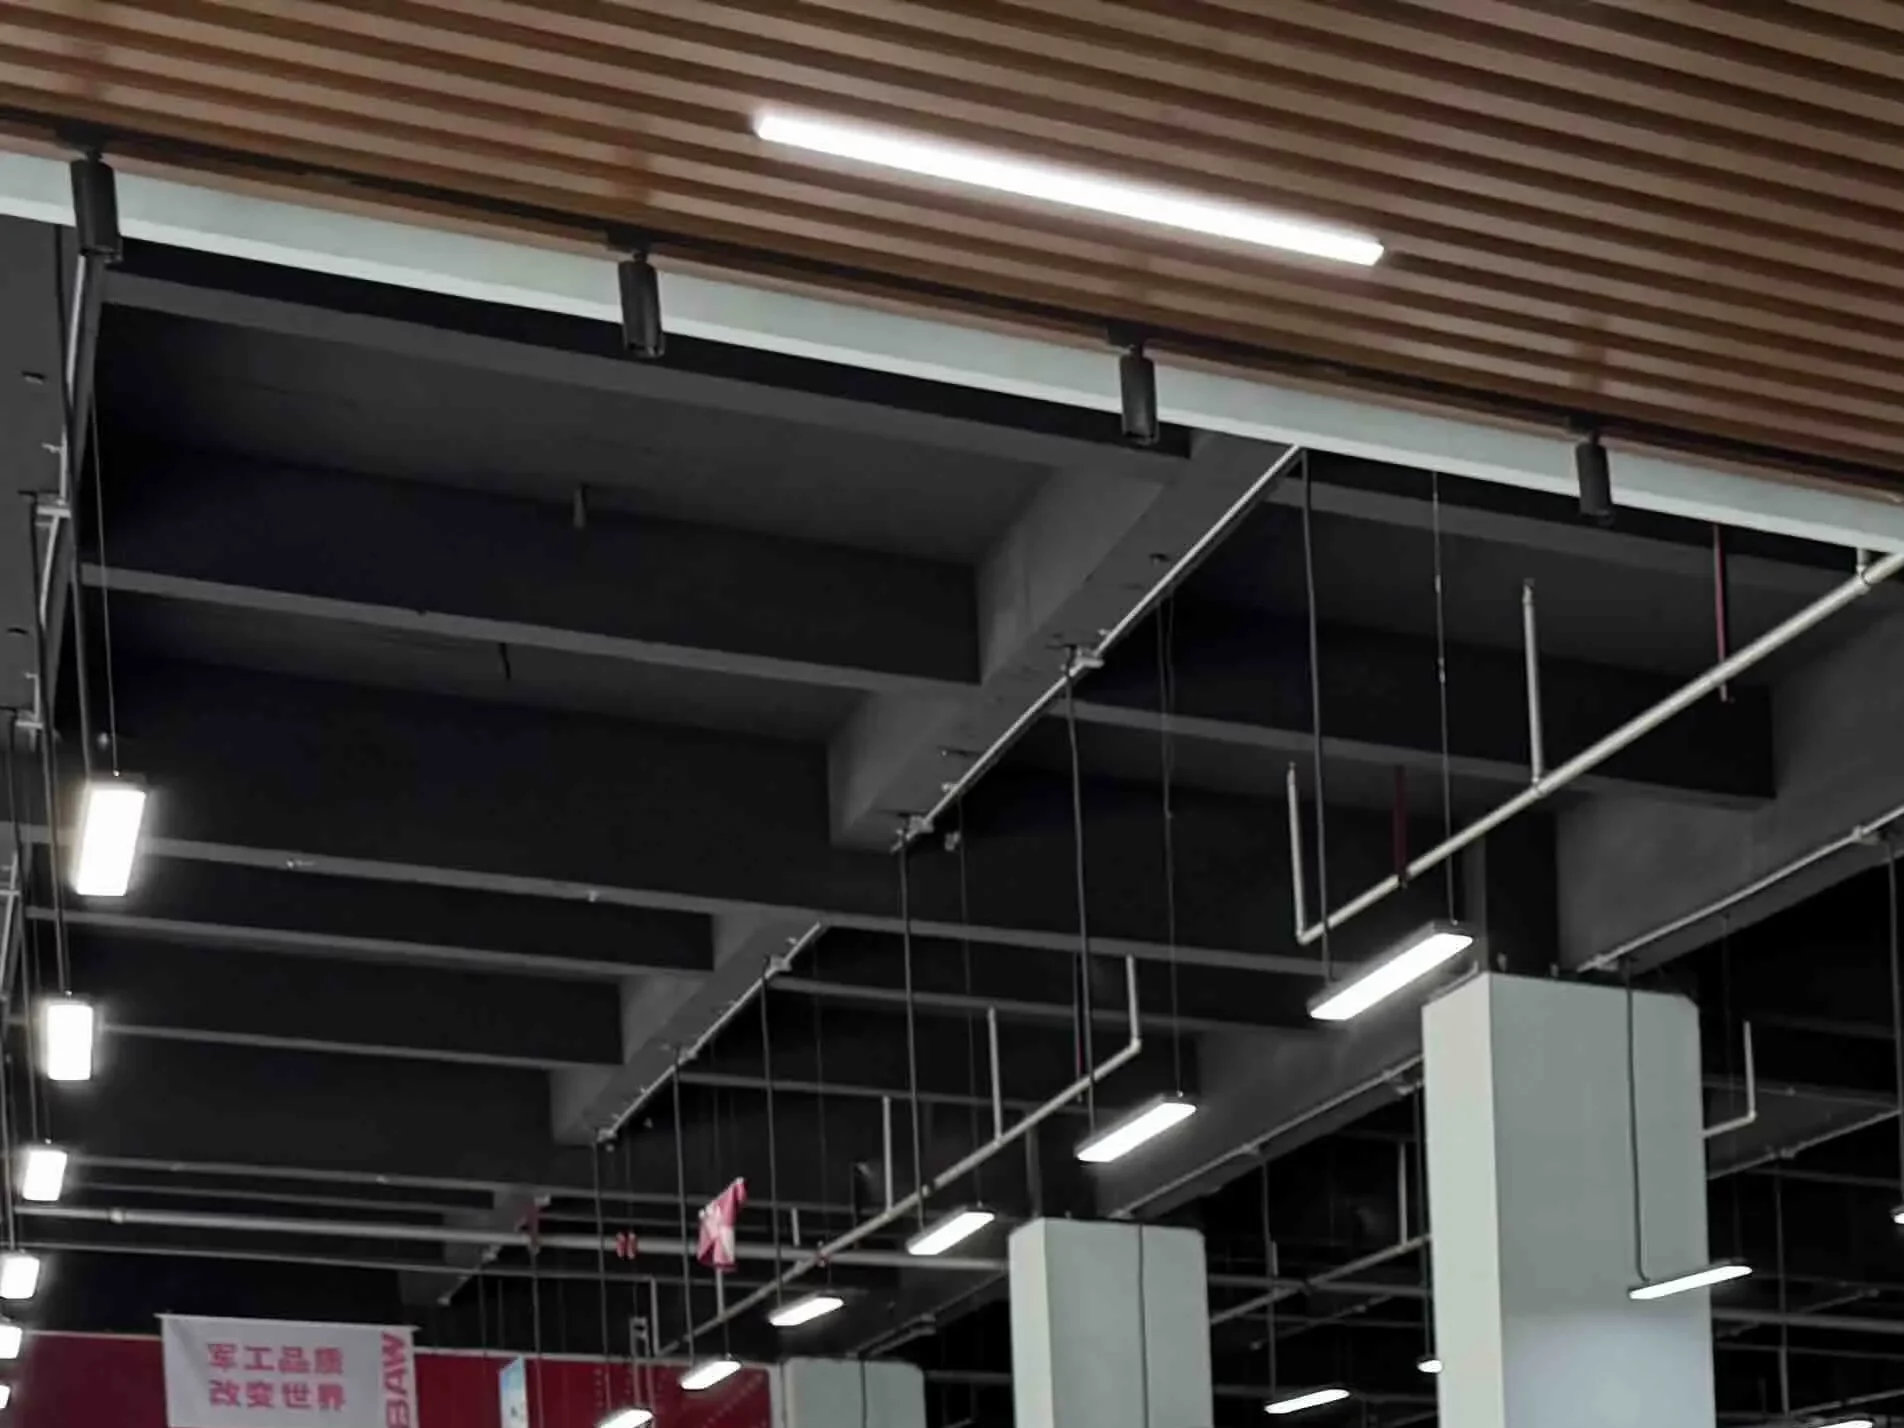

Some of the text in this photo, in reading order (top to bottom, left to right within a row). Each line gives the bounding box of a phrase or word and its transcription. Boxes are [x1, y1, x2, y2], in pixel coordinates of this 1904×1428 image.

[208, 1343, 346, 1377] 军工品质
[208, 1380, 347, 1413] 改变世界
